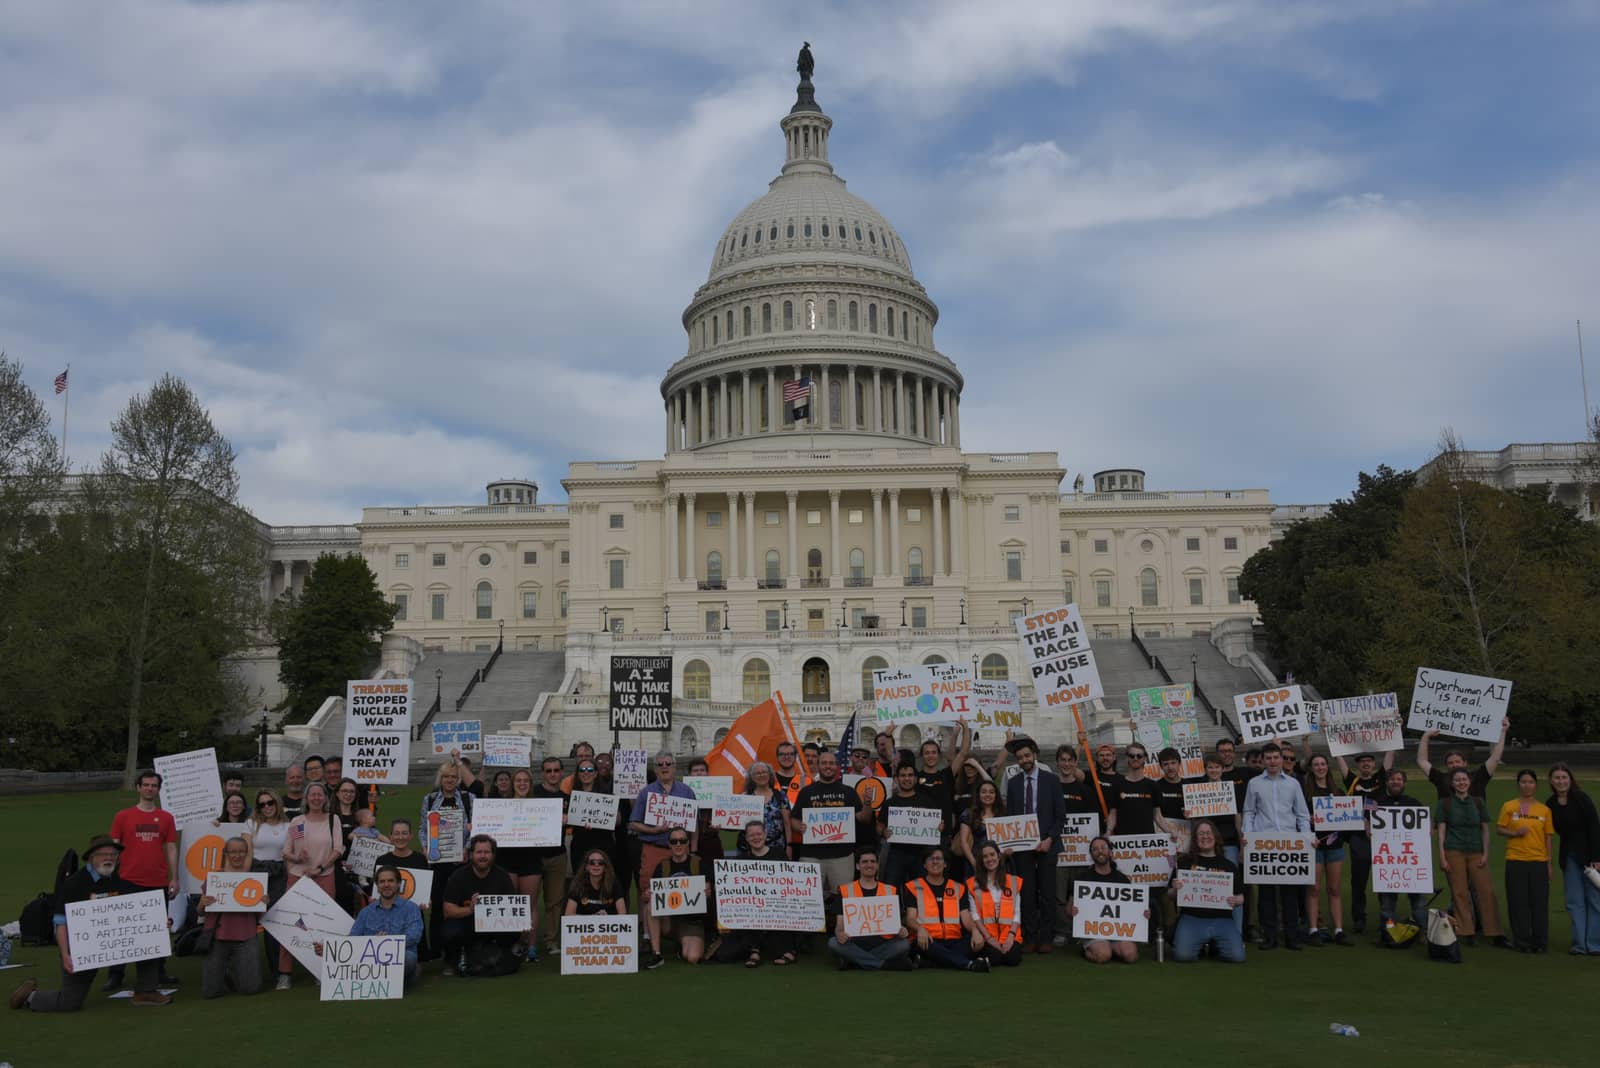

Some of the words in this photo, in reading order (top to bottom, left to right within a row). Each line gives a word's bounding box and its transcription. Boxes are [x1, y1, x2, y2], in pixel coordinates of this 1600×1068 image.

[1025, 608, 1068, 630] STOP
[1024, 628, 1058, 645] THE
[1062, 621, 1079, 636] AI
[1033, 637, 1079, 658] RACE
[613, 658, 670, 668] SUPERINTELLIGENT
[1032, 654, 1089, 678] PAUSE
[629, 669, 654, 680] AI
[874, 670, 912, 683] Treaties
[928, 665, 968, 677] Treaties
[614, 682, 638, 692] WILL
[642, 682, 670, 693] MAKE
[931, 680, 972, 694] PAUSE
[1057, 674, 1074, 688] AI
[1418, 671, 1481, 694] Superhuman
[1483, 684, 1507, 700] AI
[352, 684, 408, 694] TREATIES
[874, 685, 920, 700] PAUSED
[1046, 684, 1090, 706] NOW
[353, 696, 407, 704] STOPPED
[620, 694, 636, 706] US
[640, 694, 662, 706] ALL
[1244, 690, 1290, 708] STOP
[1440, 692, 1450, 701] is
[941, 696, 970, 712] AI
[1304, 703, 1318, 712] THE
[1325, 701, 1335, 715] AI
[1336, 696, 1373, 714] TREATY
[353, 706, 406, 716] NUCLEAR
[612, 707, 668, 728] POWERLESS
[877, 706, 918, 721] Nukes
[1242, 708, 1277, 723] THE
[1282, 703, 1300, 717] AI
[1414, 701, 1466, 720] Extinction
[1471, 714, 1492, 724] risk
[365, 718, 393, 726] WAR
[994, 710, 1022, 728] NOW
[1250, 719, 1298, 737] RACE
[1425, 720, 1432, 728] is
[1460, 724, 1480, 736] too
[348, 737, 400, 746] DEMAND
[1338, 731, 1356, 744] NOT
[1361, 730, 1372, 743] TO
[1375, 728, 1394, 742] PLAY
[358, 748, 374, 756] AN
[378, 748, 390, 756] AI
[1182, 746, 1201, 759] SAFE
[350, 759, 396, 768] TREATY
[357, 770, 388, 778] NOW
[649, 794, 668, 804] AI
[1316, 796, 1333, 808] AI
[1336, 799, 1356, 808] must
[648, 802, 696, 818] Existential
[654, 814, 688, 828] Threat
[727, 816, 740, 826] AI
[808, 814, 819, 822] AI
[822, 812, 850, 822] TREATY
[1371, 808, 1428, 830] STOP
[811, 822, 842, 838] NOW
[889, 826, 940, 838] REGULATE
[988, 821, 1022, 842] PAUSE
[1024, 821, 1039, 838] AI
[1384, 832, 1412, 840] THE
[356, 839, 391, 852] PROTECT
[1111, 840, 1168, 850] NUCLEAR:
[1255, 840, 1304, 850] SOULS
[1145, 849, 1168, 858] NRC
[1250, 853, 1308, 862] BEFORE
[1373, 856, 1418, 865] ARMS
[716, 861, 775, 876] Mitigating
[781, 863, 794, 872] the
[798, 864, 818, 874] risk
[1134, 864, 1148, 872] AI:
[1249, 866, 1308, 876] SILICON
[1379, 868, 1428, 880] RACE
[716, 874, 728, 884] of
[734, 876, 794, 884] EXTINCTION
[806, 877, 817, 888] AI
[718, 886, 752, 896] should
[755, 887, 767, 895] be
[780, 887, 812, 898] global
[1078, 886, 1144, 902] PAUSE
[476, 896, 503, 904] KEEP
[508, 896, 527, 904] THE
[720, 896, 764, 907] priority
[71, 908, 86, 917] NO
[92, 901, 134, 914] HUMANS
[140, 898, 160, 908] WIN
[844, 902, 892, 924] PAUSE
[1100, 904, 1120, 918] AI
[90, 919, 110, 927] THE
[118, 913, 147, 923] RACE
[74, 932, 89, 941] TO
[96, 924, 164, 939] ARTIFICIAL
[566, 924, 594, 933] THIS
[598, 924, 632, 932] SIGN:
[860, 920, 883, 934] AI
[1084, 920, 1136, 937] NOW
[100, 938, 135, 950] SUPER
[580, 934, 618, 944] MORE
[77, 946, 160, 966] INTELLIGENCE
[326, 940, 352, 963] NO
[360, 938, 404, 966] AGI
[566, 946, 632, 955] REGULATED
[572, 956, 608, 966] THAN
[611, 956, 624, 965] AI
[327, 964, 388, 980] WITHOUT
[332, 981, 345, 998] A
[351, 980, 390, 998] PLAN
